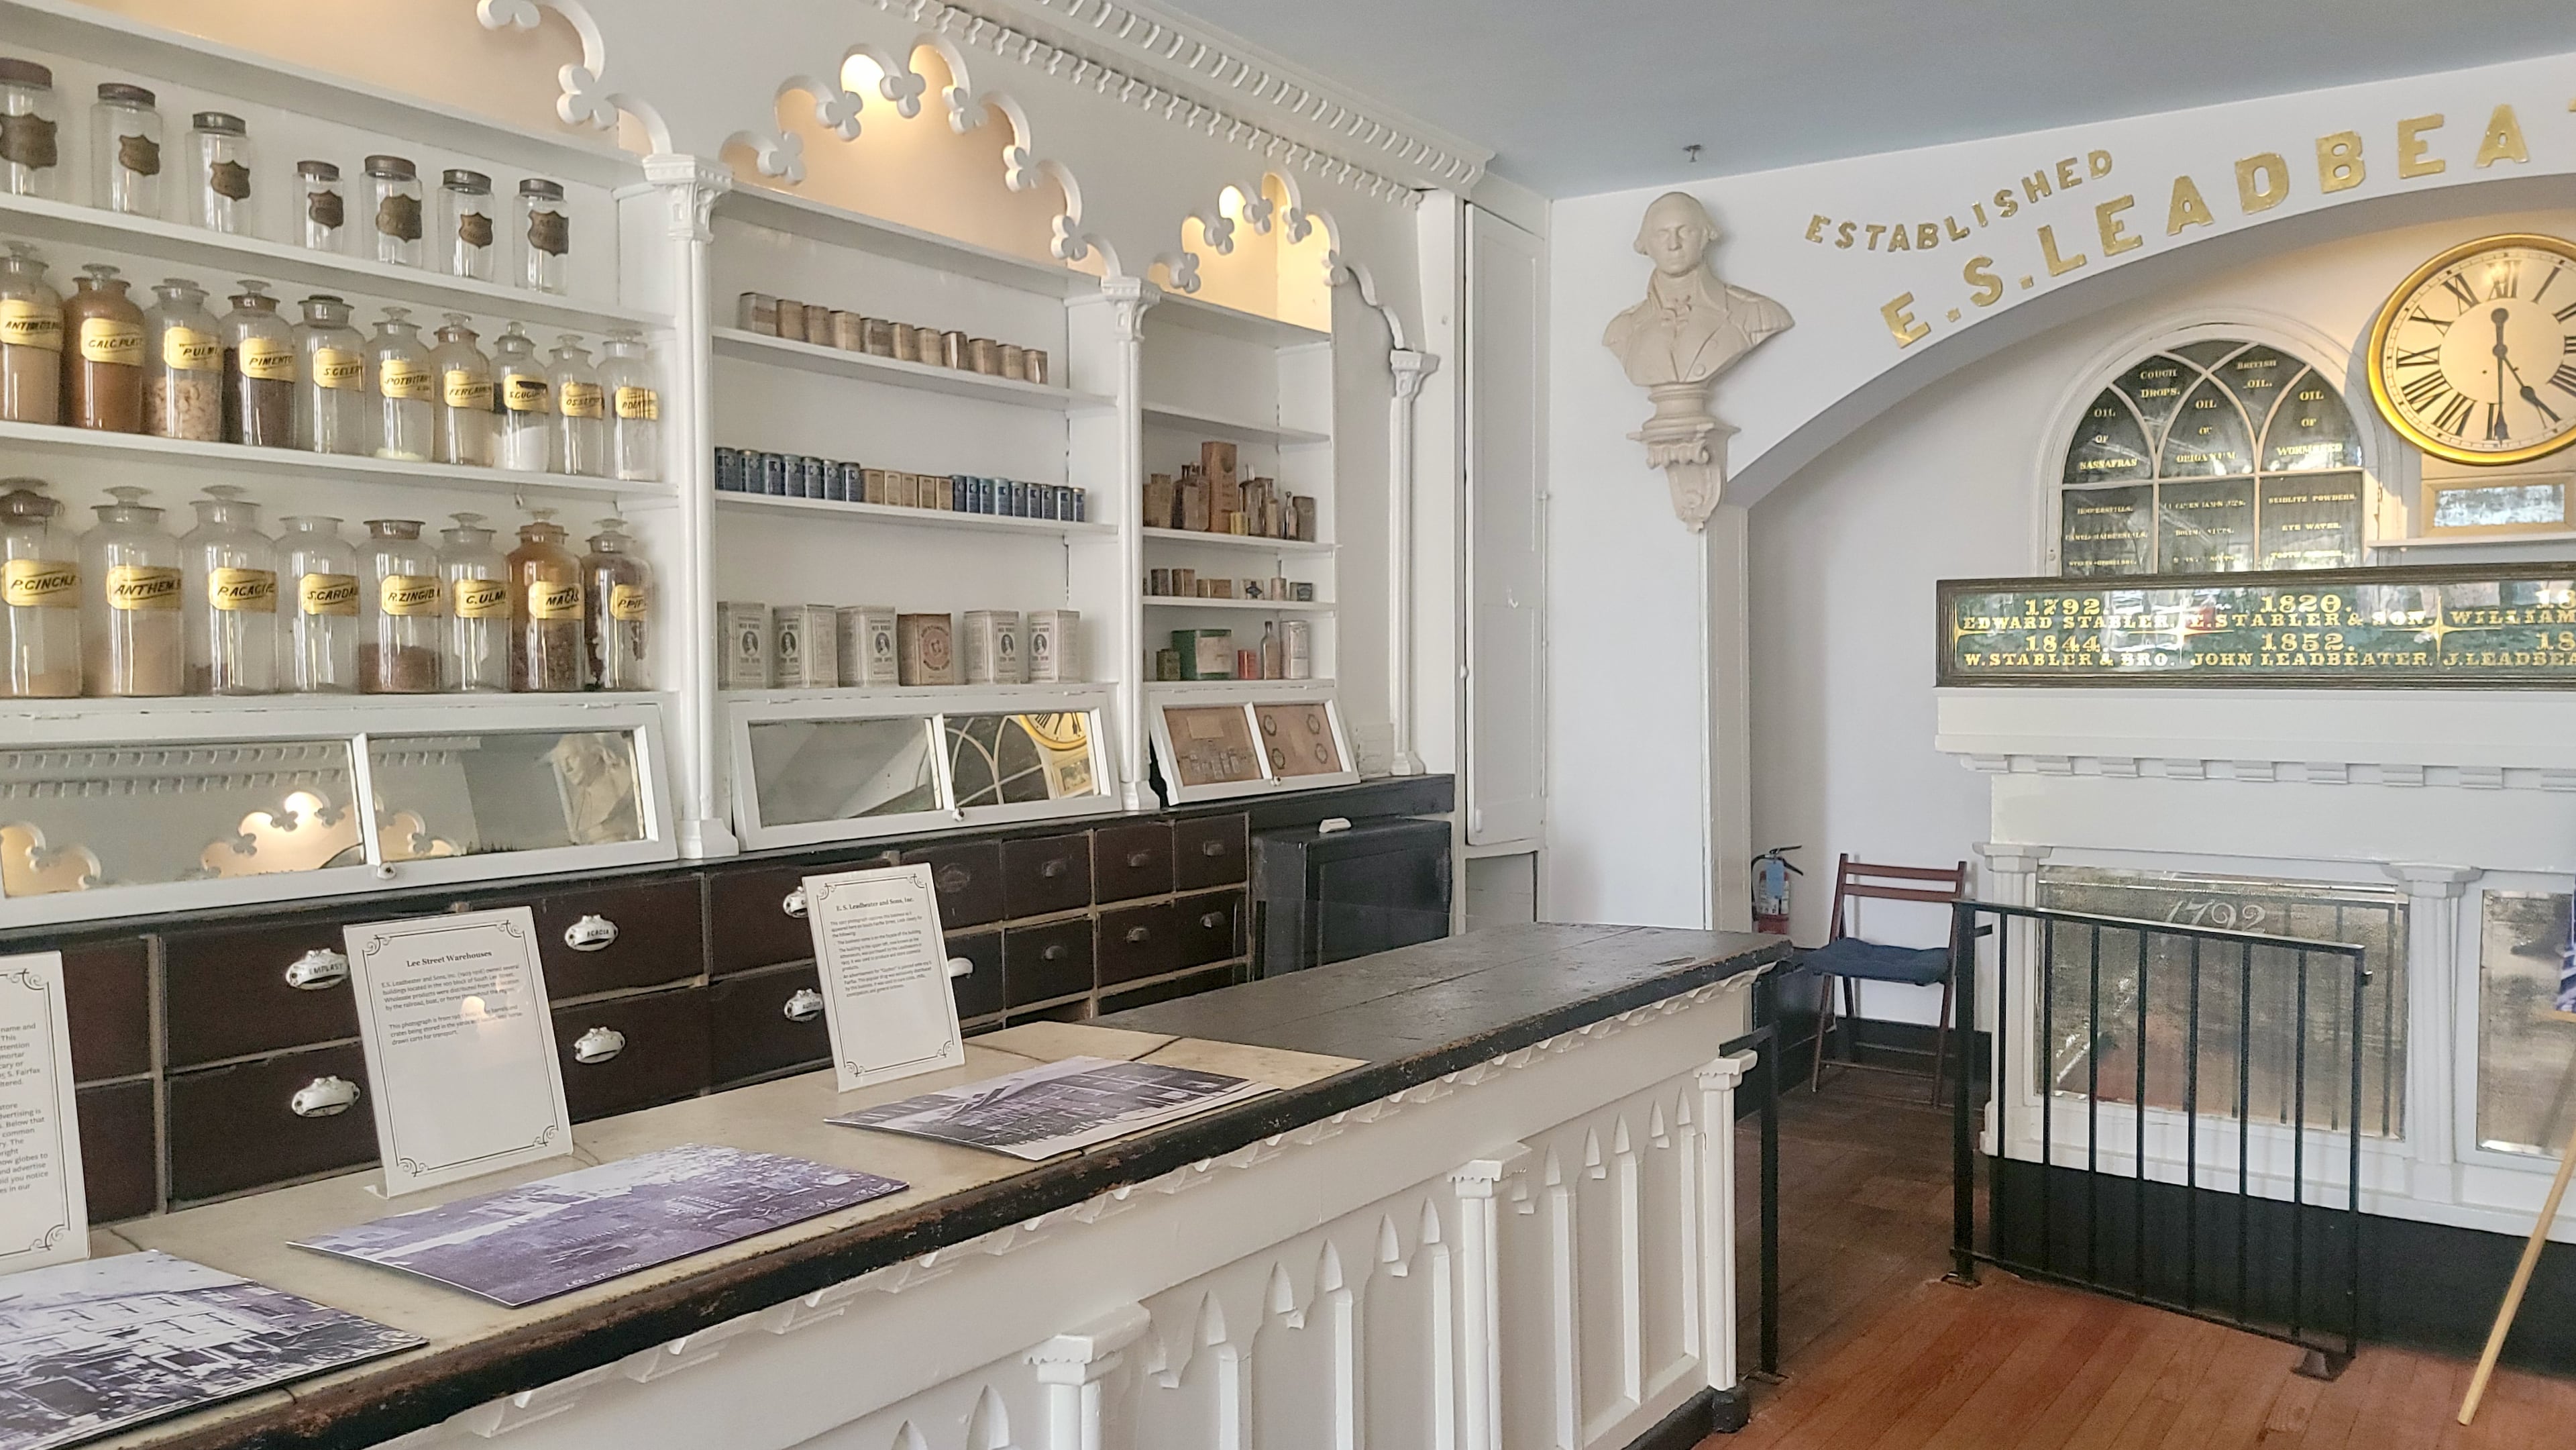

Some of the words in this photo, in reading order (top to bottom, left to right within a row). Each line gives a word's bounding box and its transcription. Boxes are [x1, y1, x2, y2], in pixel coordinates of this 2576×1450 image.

[1805, 150, 2112, 252] ESTABLISHED
[249, 355, 293, 366] PIMENTO
[2237, 359, 2277, 370] BRITISH
[2140, 369, 2178, 380] COUGH
[2140, 387, 2180, 399] DROPS.
[2300, 390, 2324, 401] OIL
[2195, 400, 2217, 409] OIL
[2301, 418, 2316, 427] OF
[2080, 458, 2138, 470] SASSAFRAS
[2025, 598, 2109, 616] 1792.
[2261, 594, 2353, 613] 1820.
[1964, 616, 2053, 630] EDWARD
[2062, 615, 2175, 630] STABLER.
[2347, 613, 2364, 627] &
[2449, 609, 2576, 625] WILLIAM
[2025, 635, 2110, 653] 1844.
[2261, 632, 2355, 652] 1852.
[2099, 652, 2114, 666] &
[2121, 652, 2176, 666] BRO.
[2190, 652, 2253, 666] JOHN
[2261, 652, 2434, 666] LEADBEATER.
[2165, 899, 2265, 933] 1792
[406, 960, 421, 968] Lee
[421, 955, 445, 966] Street
[446, 951, 492, 963] Warehouses
[1, 1025, 21, 1033] name
[22, 1022, 36, 1031] and
[1, 1034, 17, 1042] This
[16, 1067, 40, 1076] Fairfax
[6, 1120, 28, 1129] Below
[30, 1116, 45, 1125] that
[2, 1127, 36, 1138] common
[10, 1138, 25, 1146] The
[15, 1154, 39, 1166] globes
[12, 1161, 46, 1173] advertise
[11, 1176, 24, 1184] you
[25, 1170, 49, 1180] notice
[566, 1278, 587, 1287] LEE
